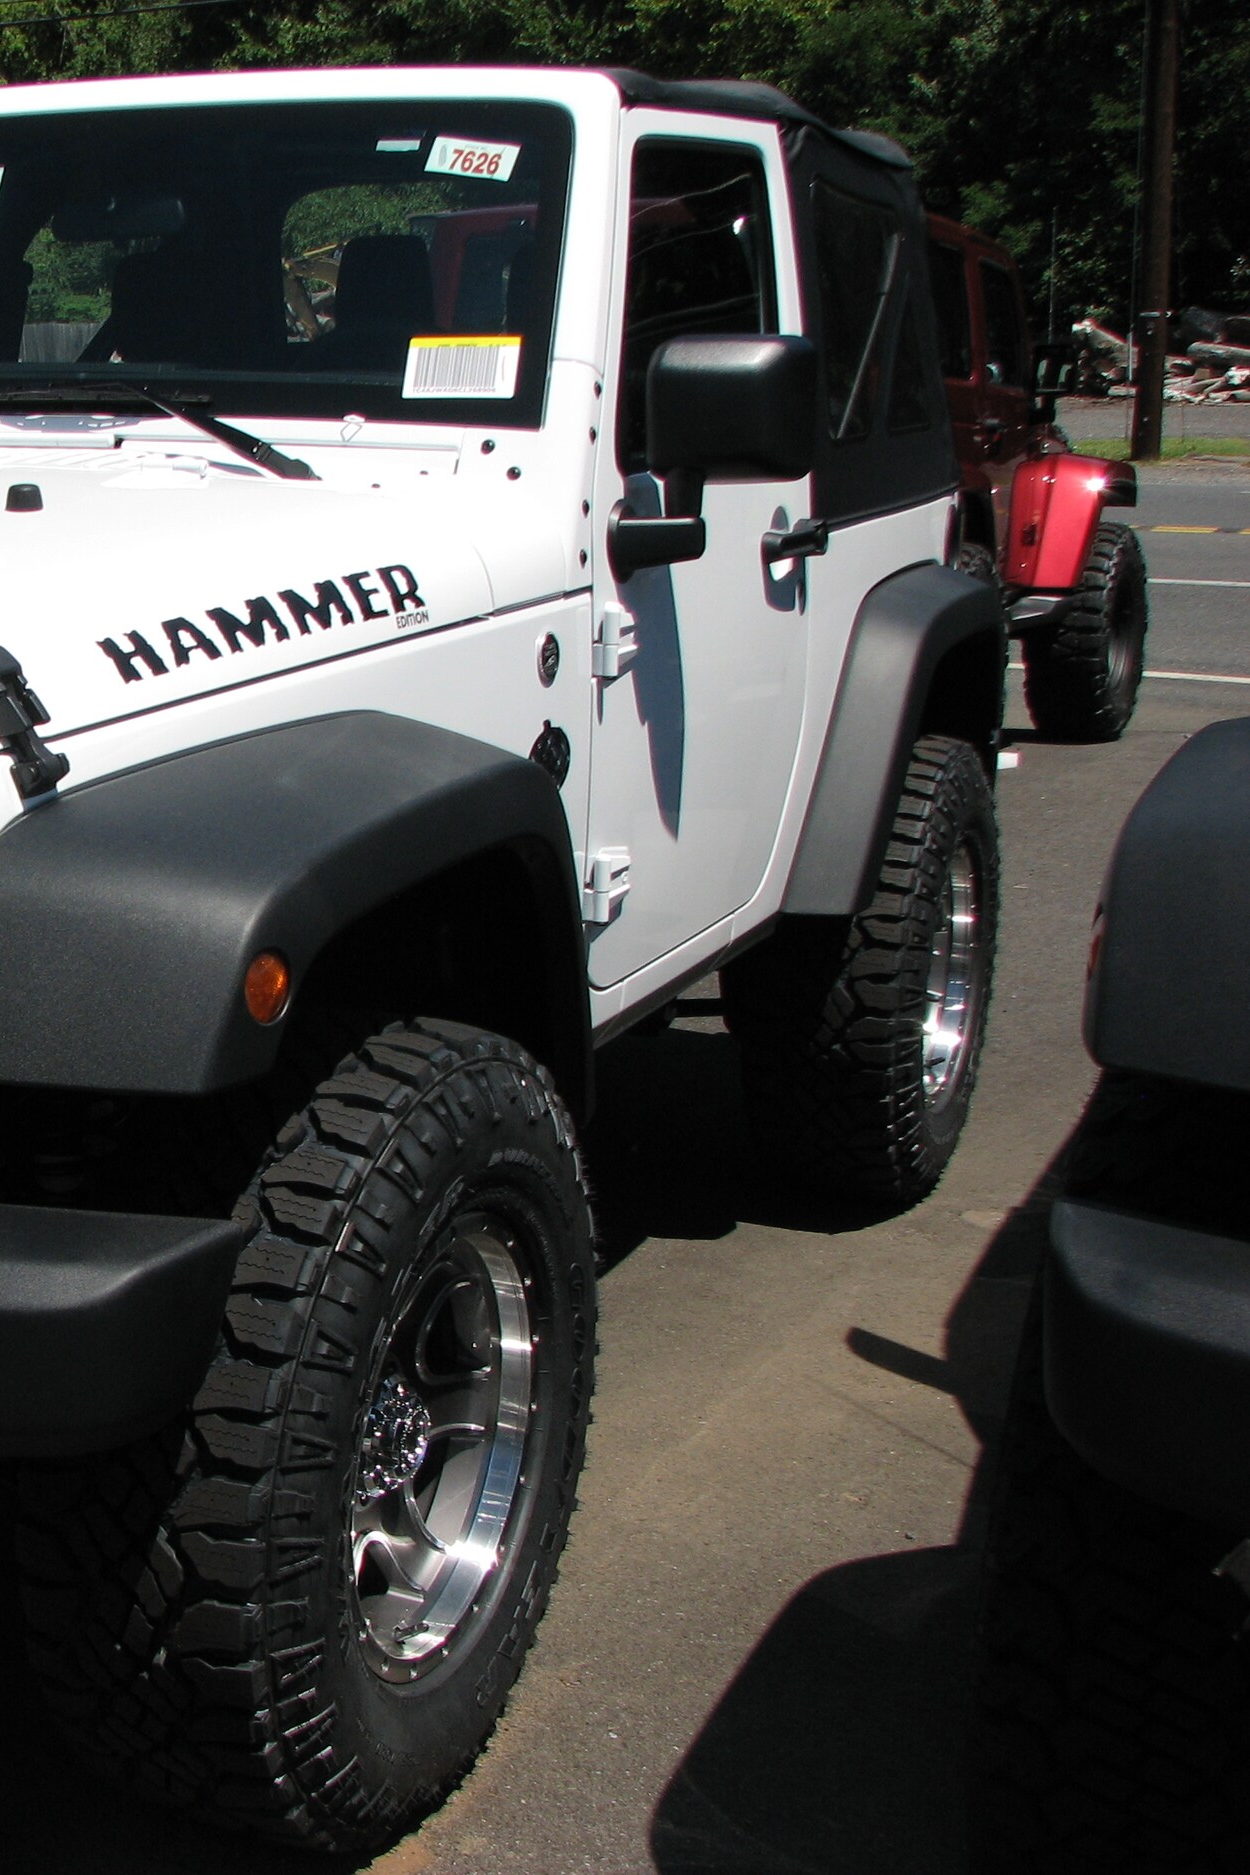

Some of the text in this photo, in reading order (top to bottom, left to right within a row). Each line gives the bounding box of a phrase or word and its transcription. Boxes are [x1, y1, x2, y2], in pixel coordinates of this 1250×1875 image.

[448, 148, 502, 175] 7626
[95, 564, 426, 684] HAMMER
[395, 610, 430, 630] EDITION
